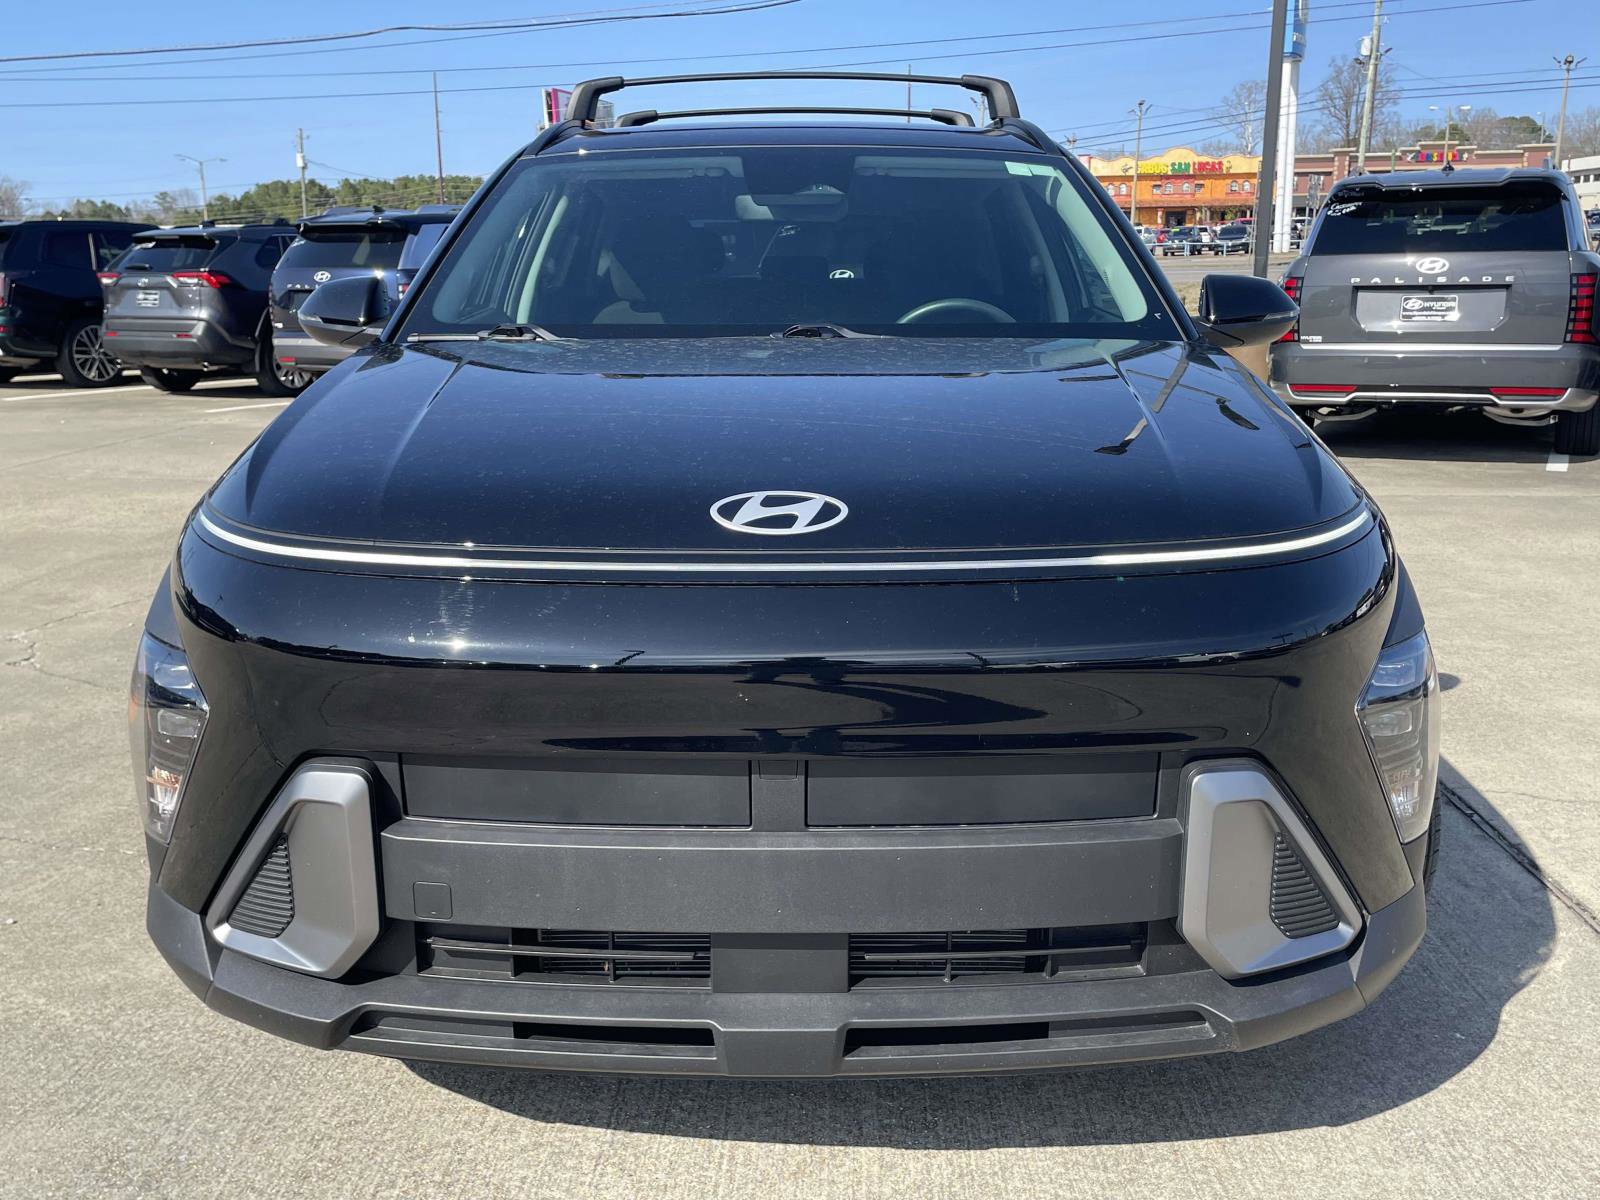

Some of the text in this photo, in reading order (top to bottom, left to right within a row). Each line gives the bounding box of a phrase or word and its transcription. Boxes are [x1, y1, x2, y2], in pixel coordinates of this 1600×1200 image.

[1170, 161, 1191, 174] SAN
[1192, 160, 1223, 173] LUCAS
[1350, 275, 1515, 284] PALISADE
